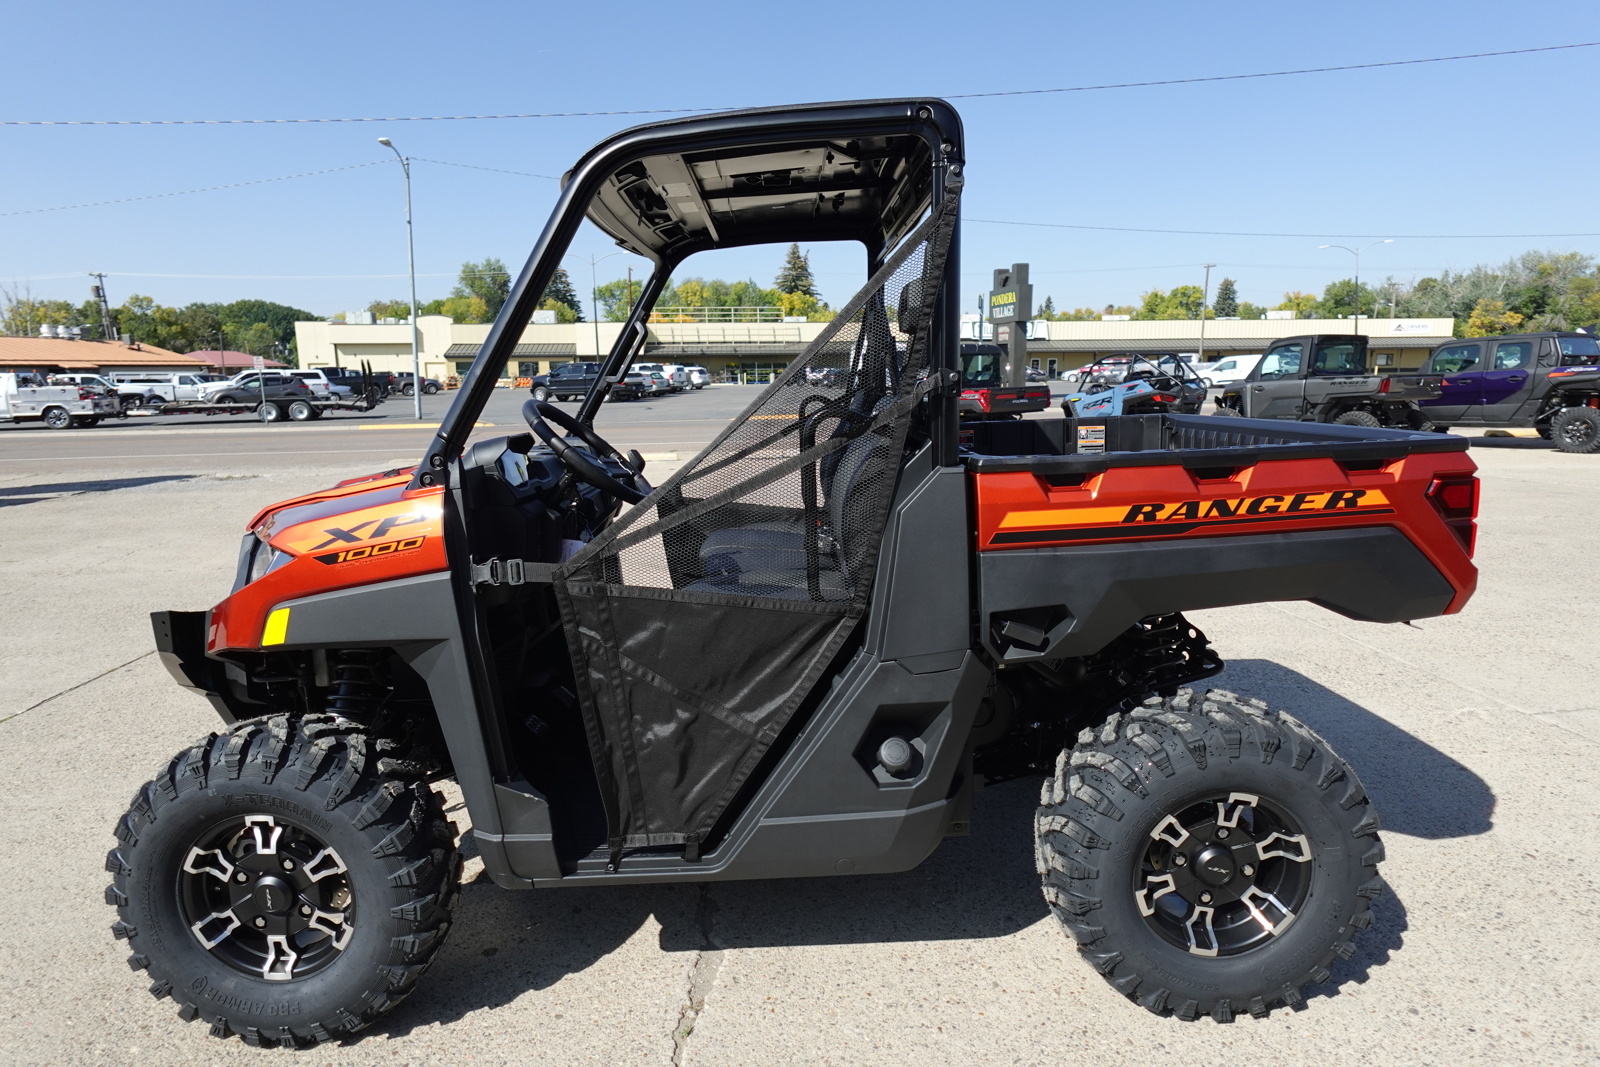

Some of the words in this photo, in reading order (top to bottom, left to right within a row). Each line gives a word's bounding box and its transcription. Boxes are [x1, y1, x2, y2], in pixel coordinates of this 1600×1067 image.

[991, 292, 1016, 306] PONDERA
[993, 305, 1014, 318] VILLAGE
[1082, 397, 1113, 411] RZR
[1119, 489, 1367, 525] RANGER
[306, 514, 431, 552] XP
[336, 536, 425, 562] 1000
[358, 554, 401, 565] OVERHEAD
[220, 792, 334, 834] X-TERRAIN
[204, 985, 266, 1015] ARMOR
[267, 1001, 301, 1017] PRO
